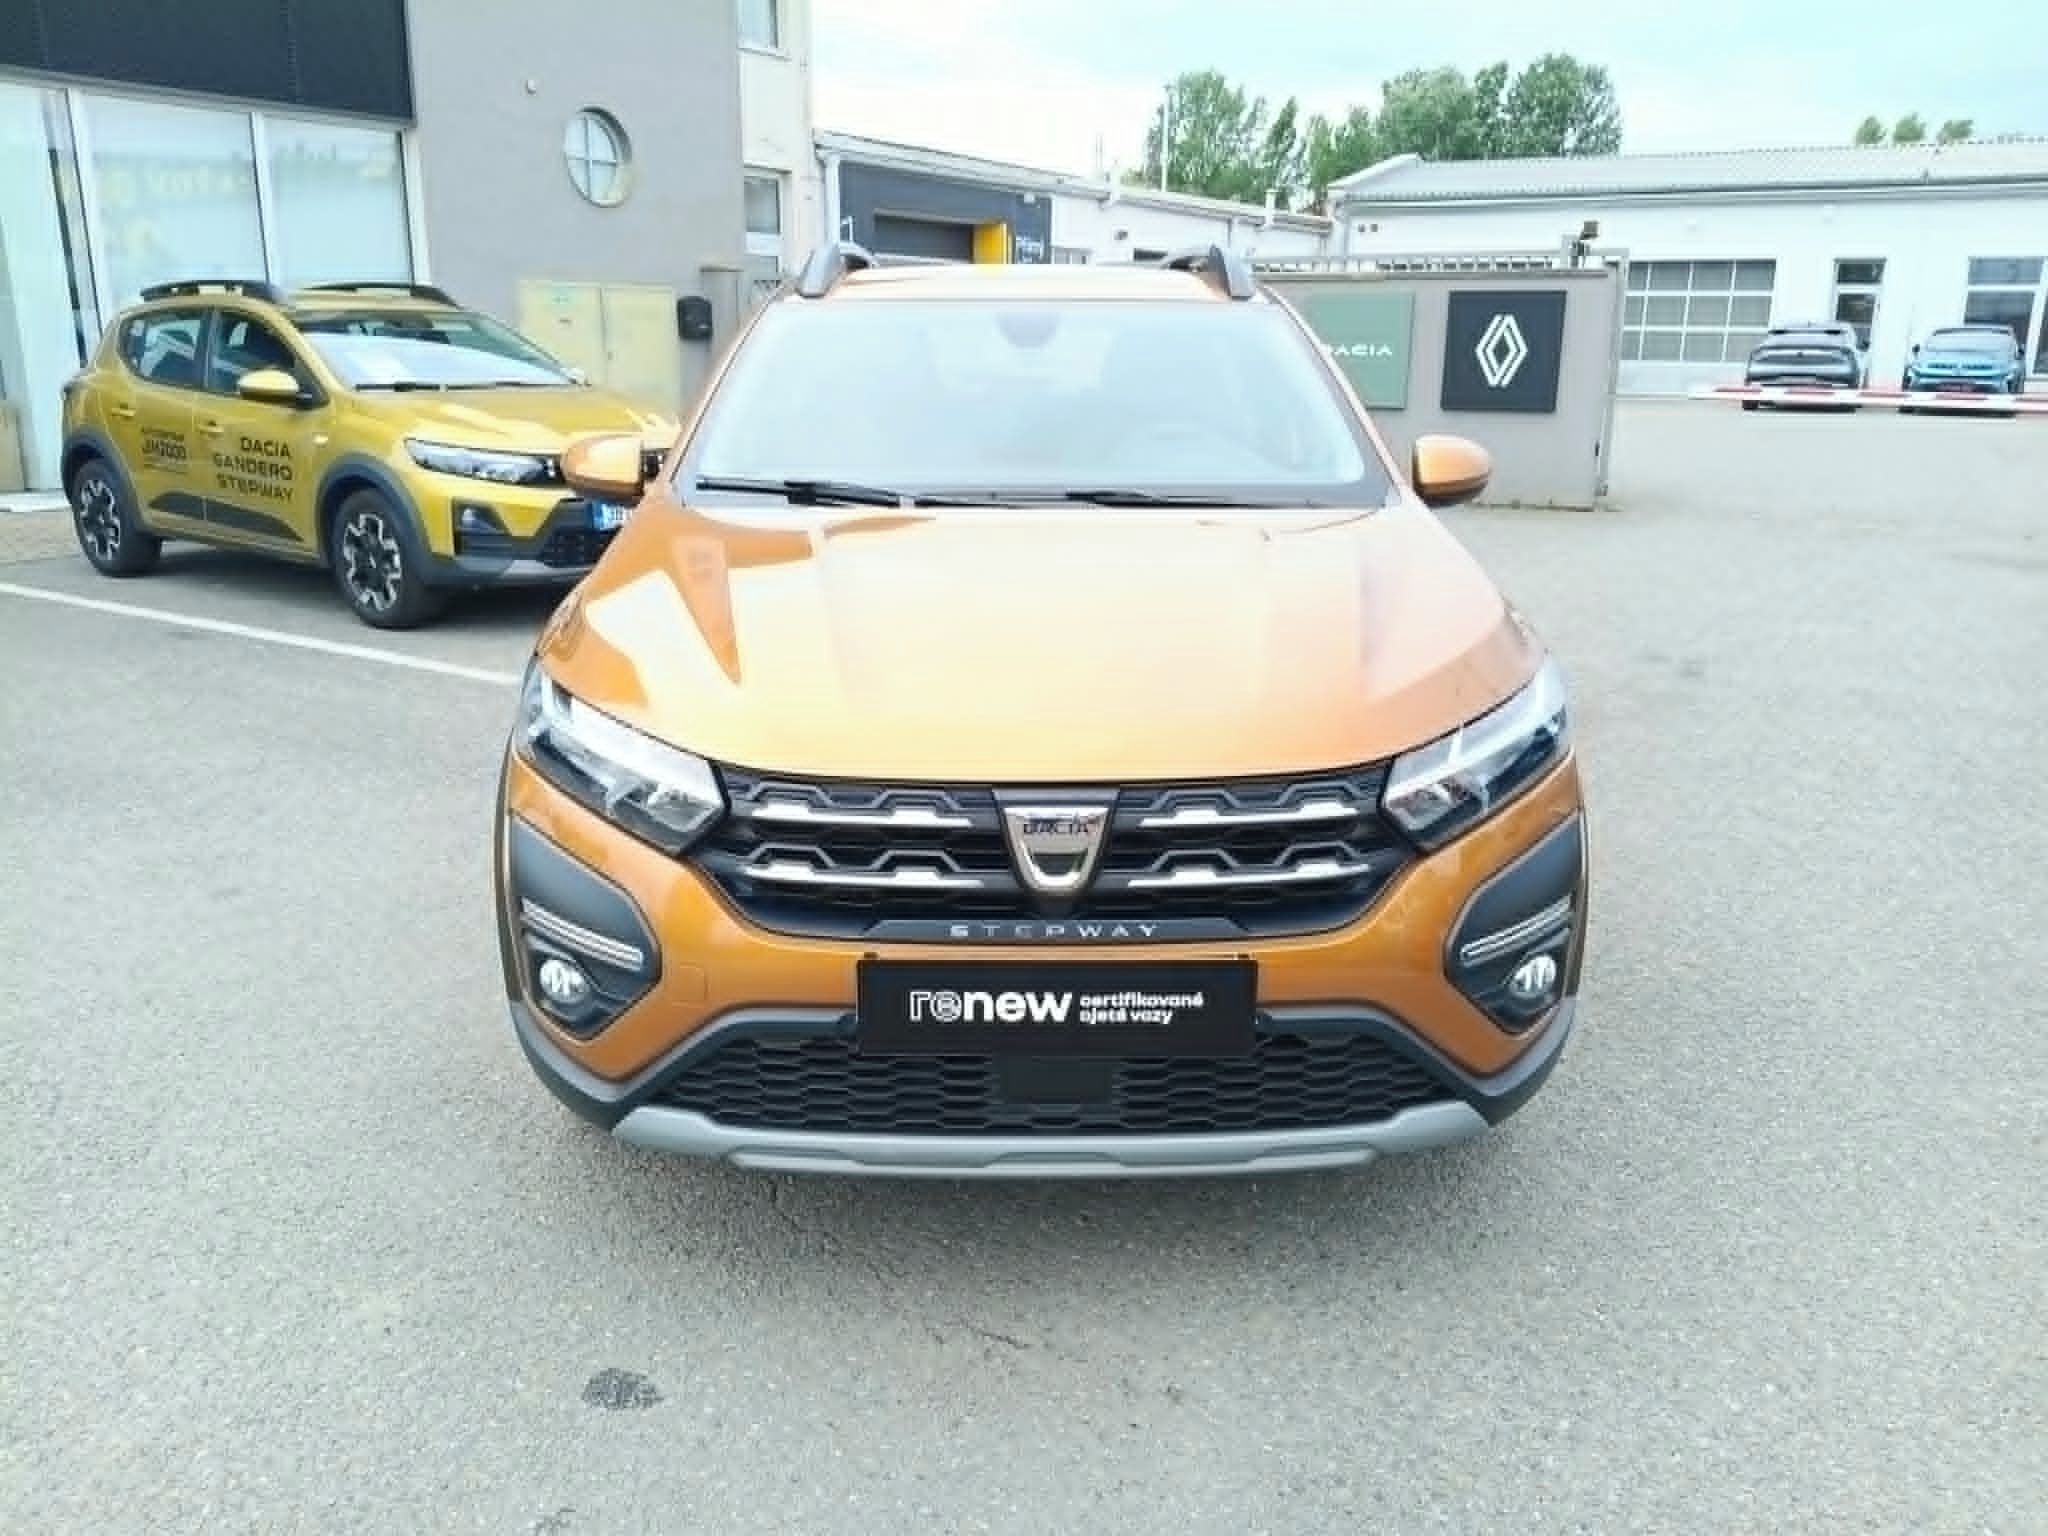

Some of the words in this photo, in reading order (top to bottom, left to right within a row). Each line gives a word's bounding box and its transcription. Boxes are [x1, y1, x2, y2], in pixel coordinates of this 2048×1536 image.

[240, 436, 293, 459] DACIA
[213, 452, 294, 482] SANDERO
[216, 471, 295, 502] STEPWAY
[949, 924, 1158, 938] STEPWAY
[908, 989, 1073, 1023] renew
[1079, 991, 1204, 1008] certifikované
[1130, 1009, 1174, 1025] vozy
